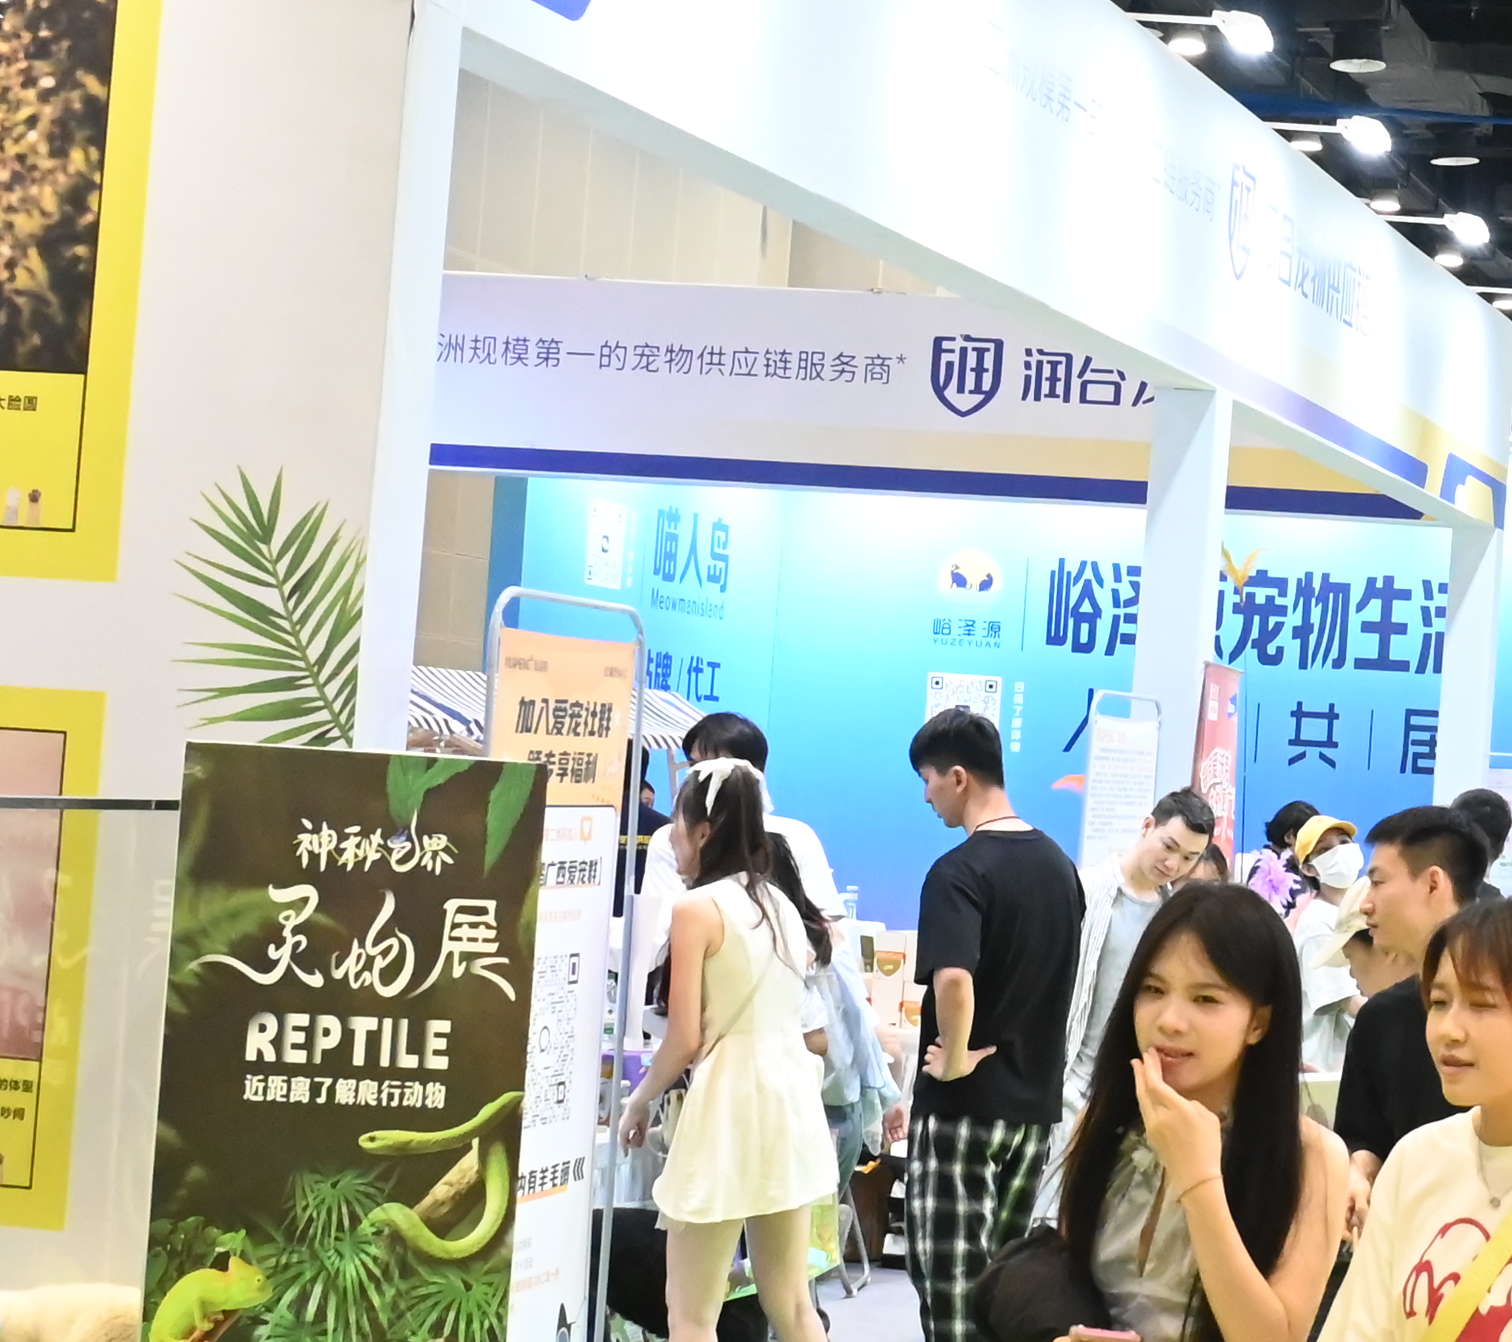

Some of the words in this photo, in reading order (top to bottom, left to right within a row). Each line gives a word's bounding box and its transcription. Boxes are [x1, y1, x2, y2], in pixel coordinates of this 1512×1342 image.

[653, 506, 730, 593] 喵人岛
[932, 617, 1002, 639] 峪泽源
[932, 638, 1001, 649] YUZEYUAN
[515, 697, 613, 738] 加入爱宠社群
[245, 1012, 452, 1070] REPTILE
[243, 1074, 446, 1109] 近距离了解爬行动物
